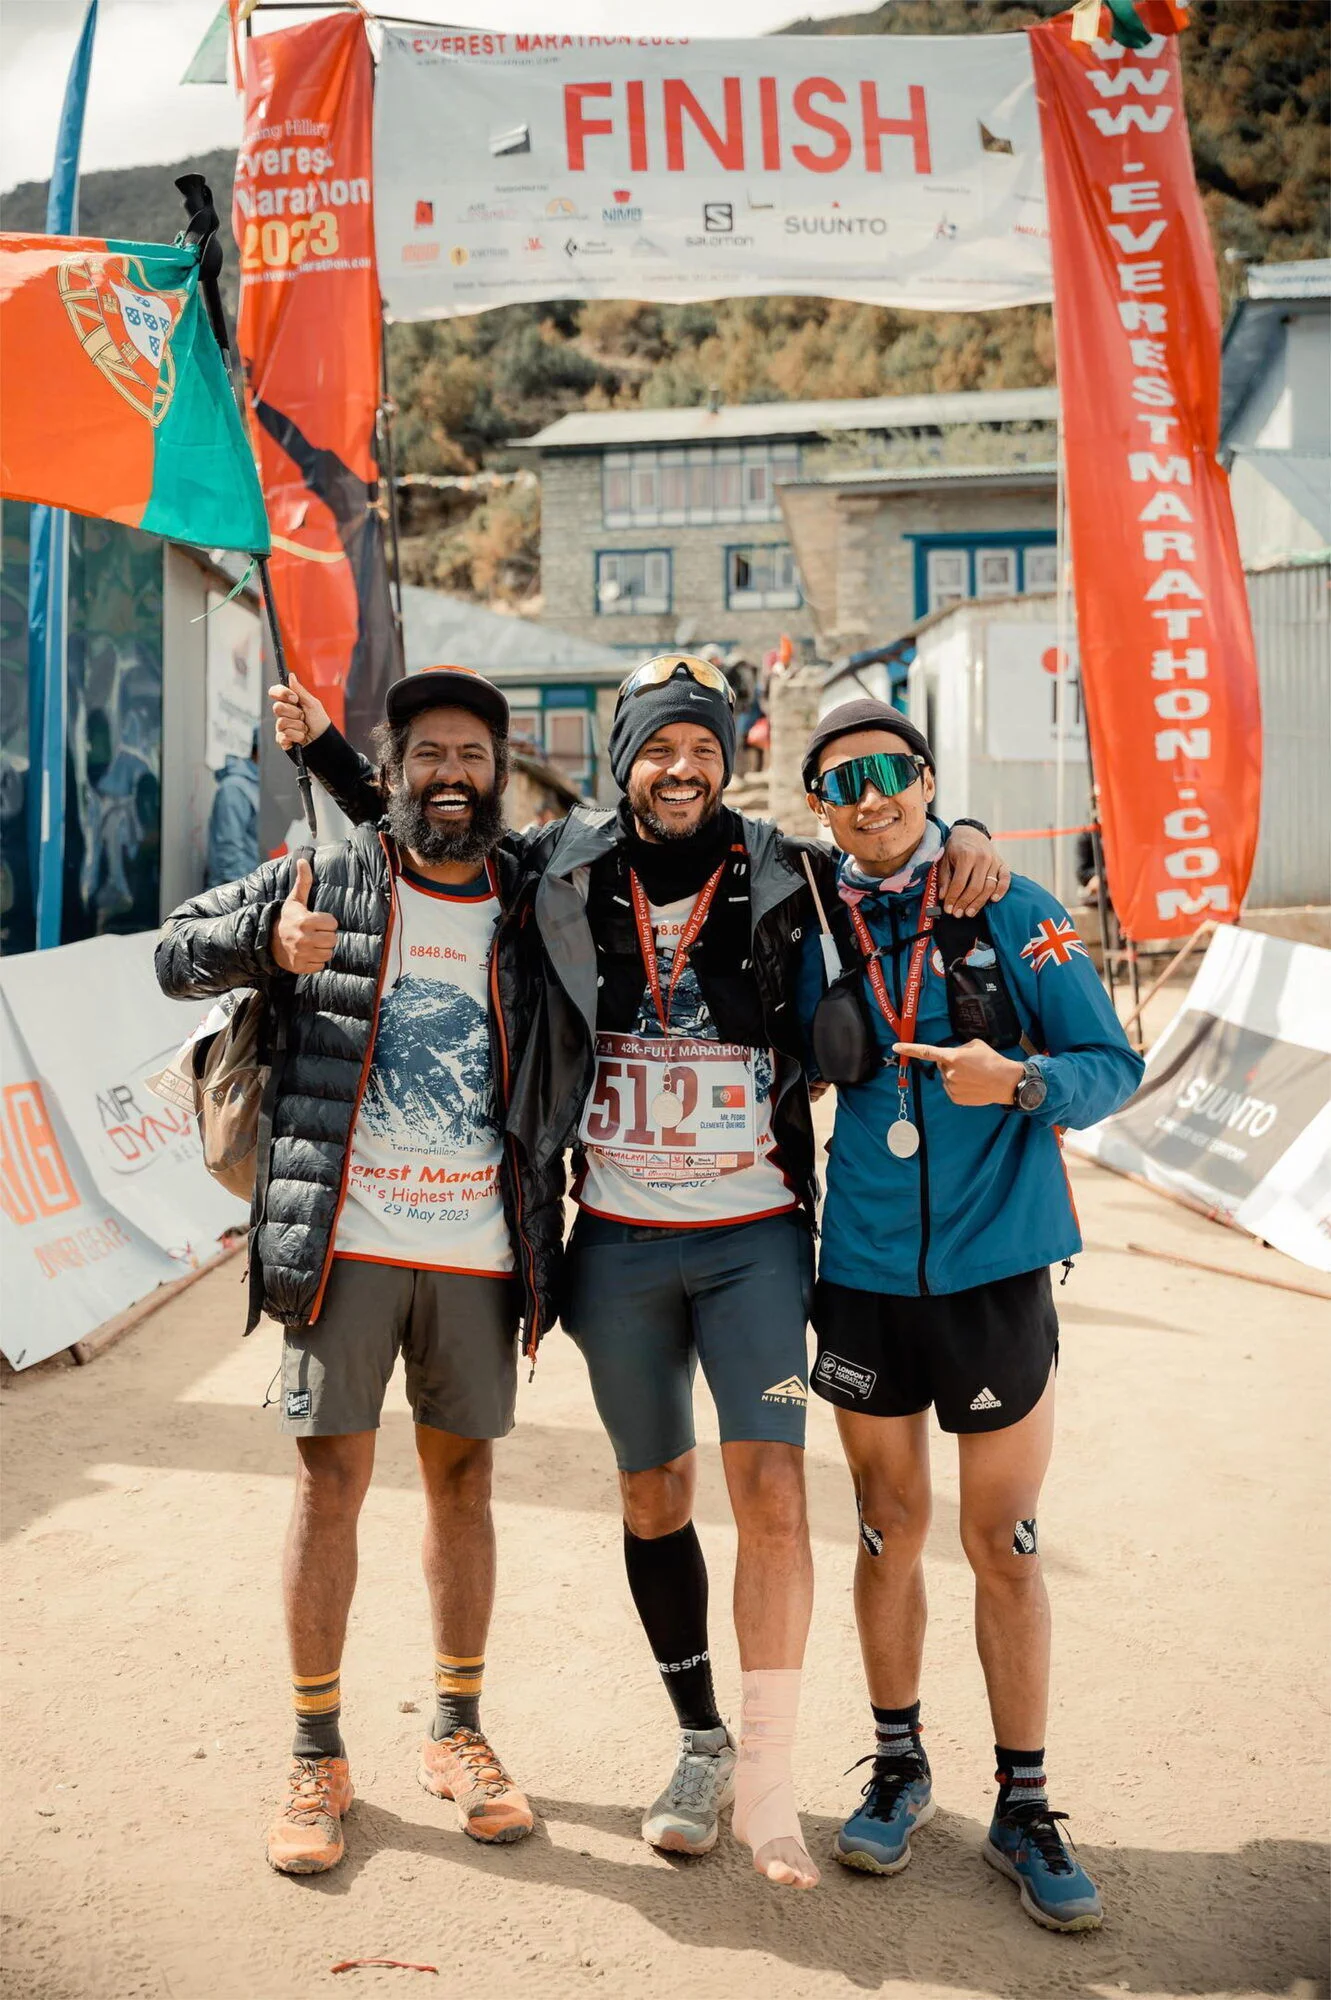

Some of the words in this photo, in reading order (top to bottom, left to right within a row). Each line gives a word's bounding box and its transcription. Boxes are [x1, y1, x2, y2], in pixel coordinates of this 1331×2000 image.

[563, 76, 932, 175] FINISH
[784, 216, 888, 236] SUUNTO
[241, 211, 339, 269] 2023
[409, 945, 467, 962] 8848.86m
[877, 987, 896, 1025] Tenzing
[903, 980, 919, 1019] Tenzing
[679, 1043, 750, 1057] MARATHON
[587, 1061, 698, 1147] 512
[1176, 1077, 1278, 1138] SUUNTO
[392, 1186, 454, 1207] Highest
[383, 1201, 402, 1215] 29
[406, 1207, 436, 1224] May
[438, 1209, 469, 1221] 2023
[835, 1370, 870, 1389] MARATHON
[837, 1364, 864, 1381] LONDON
[761, 1394, 788, 1404] NIKE
[970, 1400, 1002, 1410] adidas
